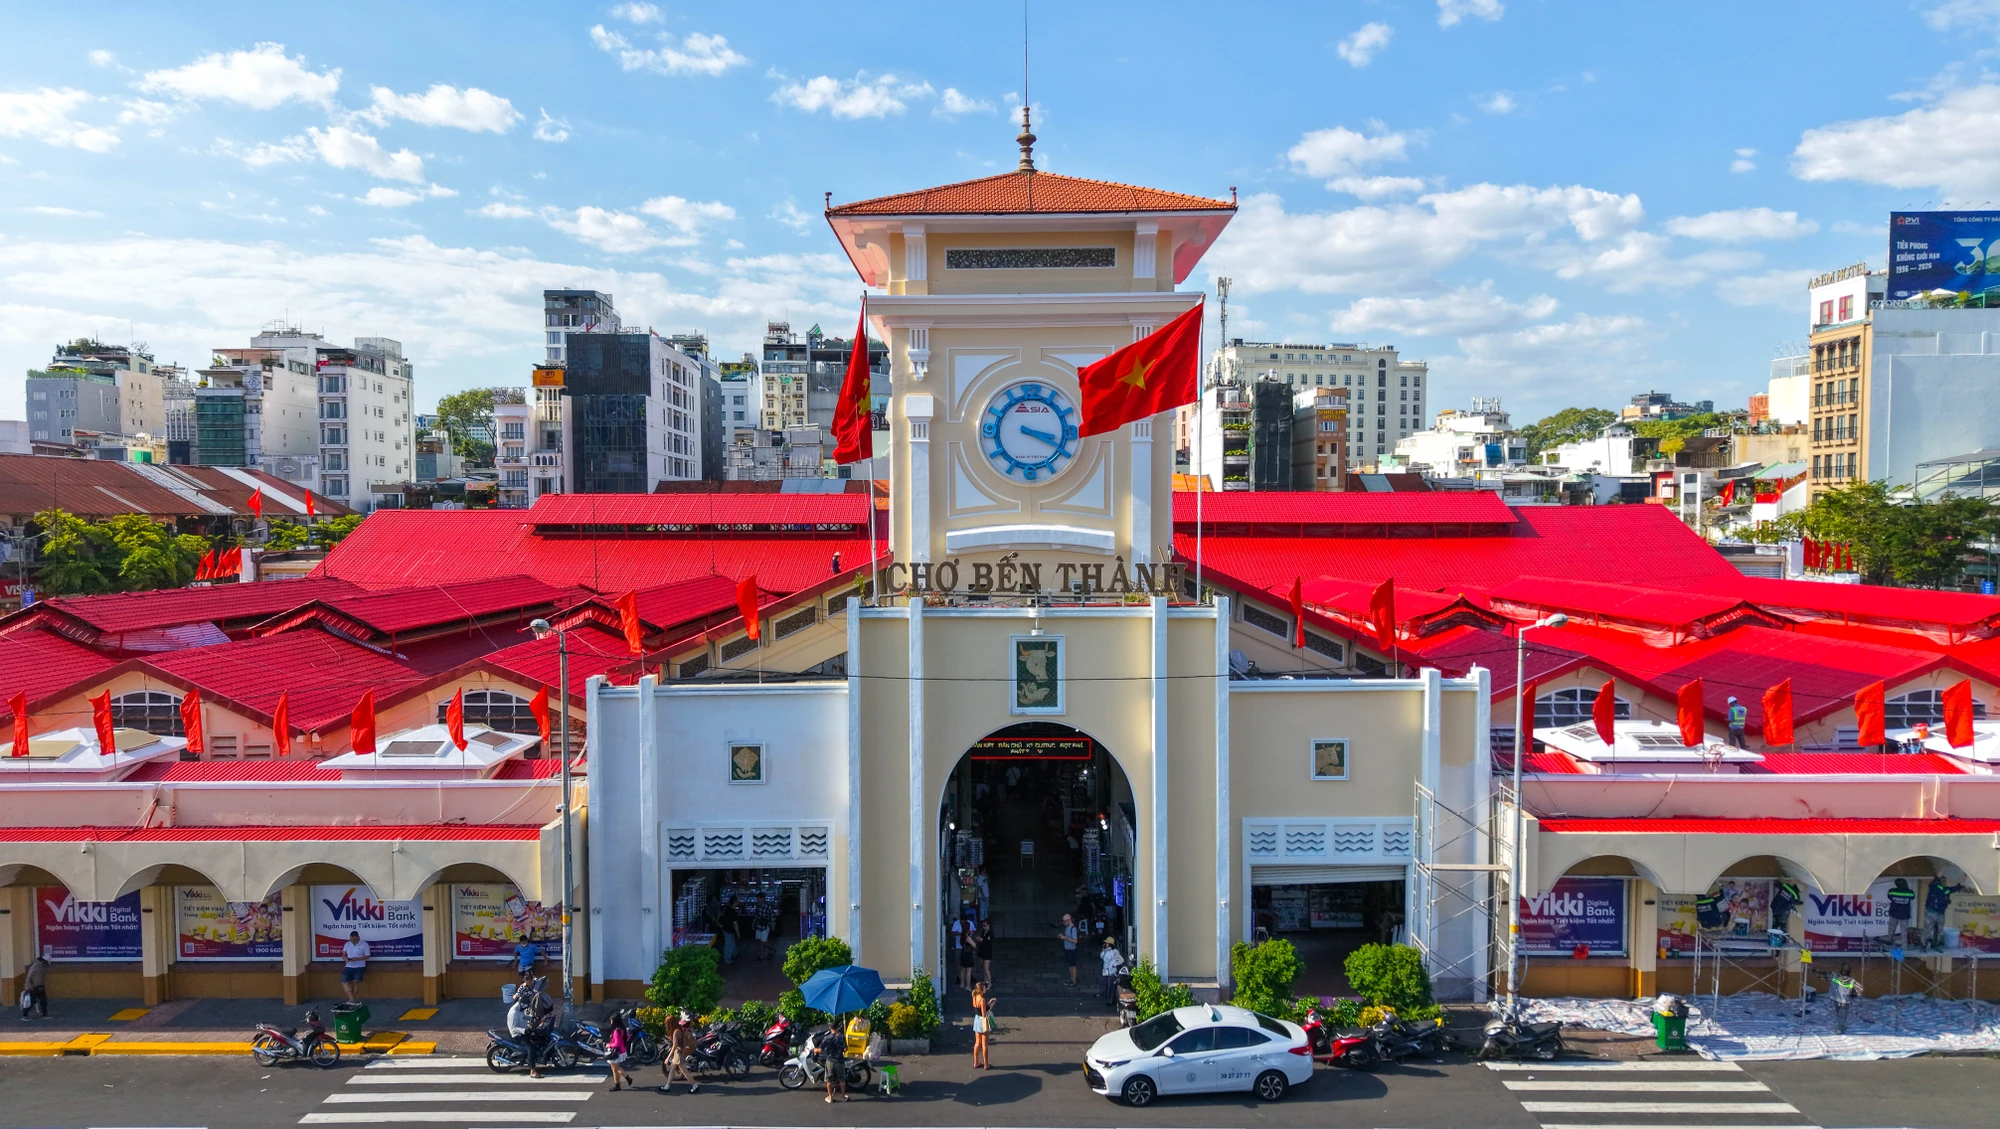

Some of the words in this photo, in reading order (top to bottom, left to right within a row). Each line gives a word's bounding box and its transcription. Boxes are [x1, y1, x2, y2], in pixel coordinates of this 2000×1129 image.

[1836, 262, 1867, 282] HOTEL
[886, 558, 960, 597] CHỢ
[972, 551, 1042, 594] BẾN
[1055, 555, 1188, 594] THÀNH
[184, 888, 202, 898] Vikki
[460, 886, 479, 896] Vikki
[44, 892, 107, 922] Vikki
[110, 907, 131, 915] Digital
[322, 888, 384, 920] Vikki
[1525, 892, 1584, 916] Vikki
[1587, 906, 1615, 916] Bank
[1809, 894, 1872, 916] Vikki
[110, 913, 138, 922] Bank
[388, 912, 416, 920] Bank
